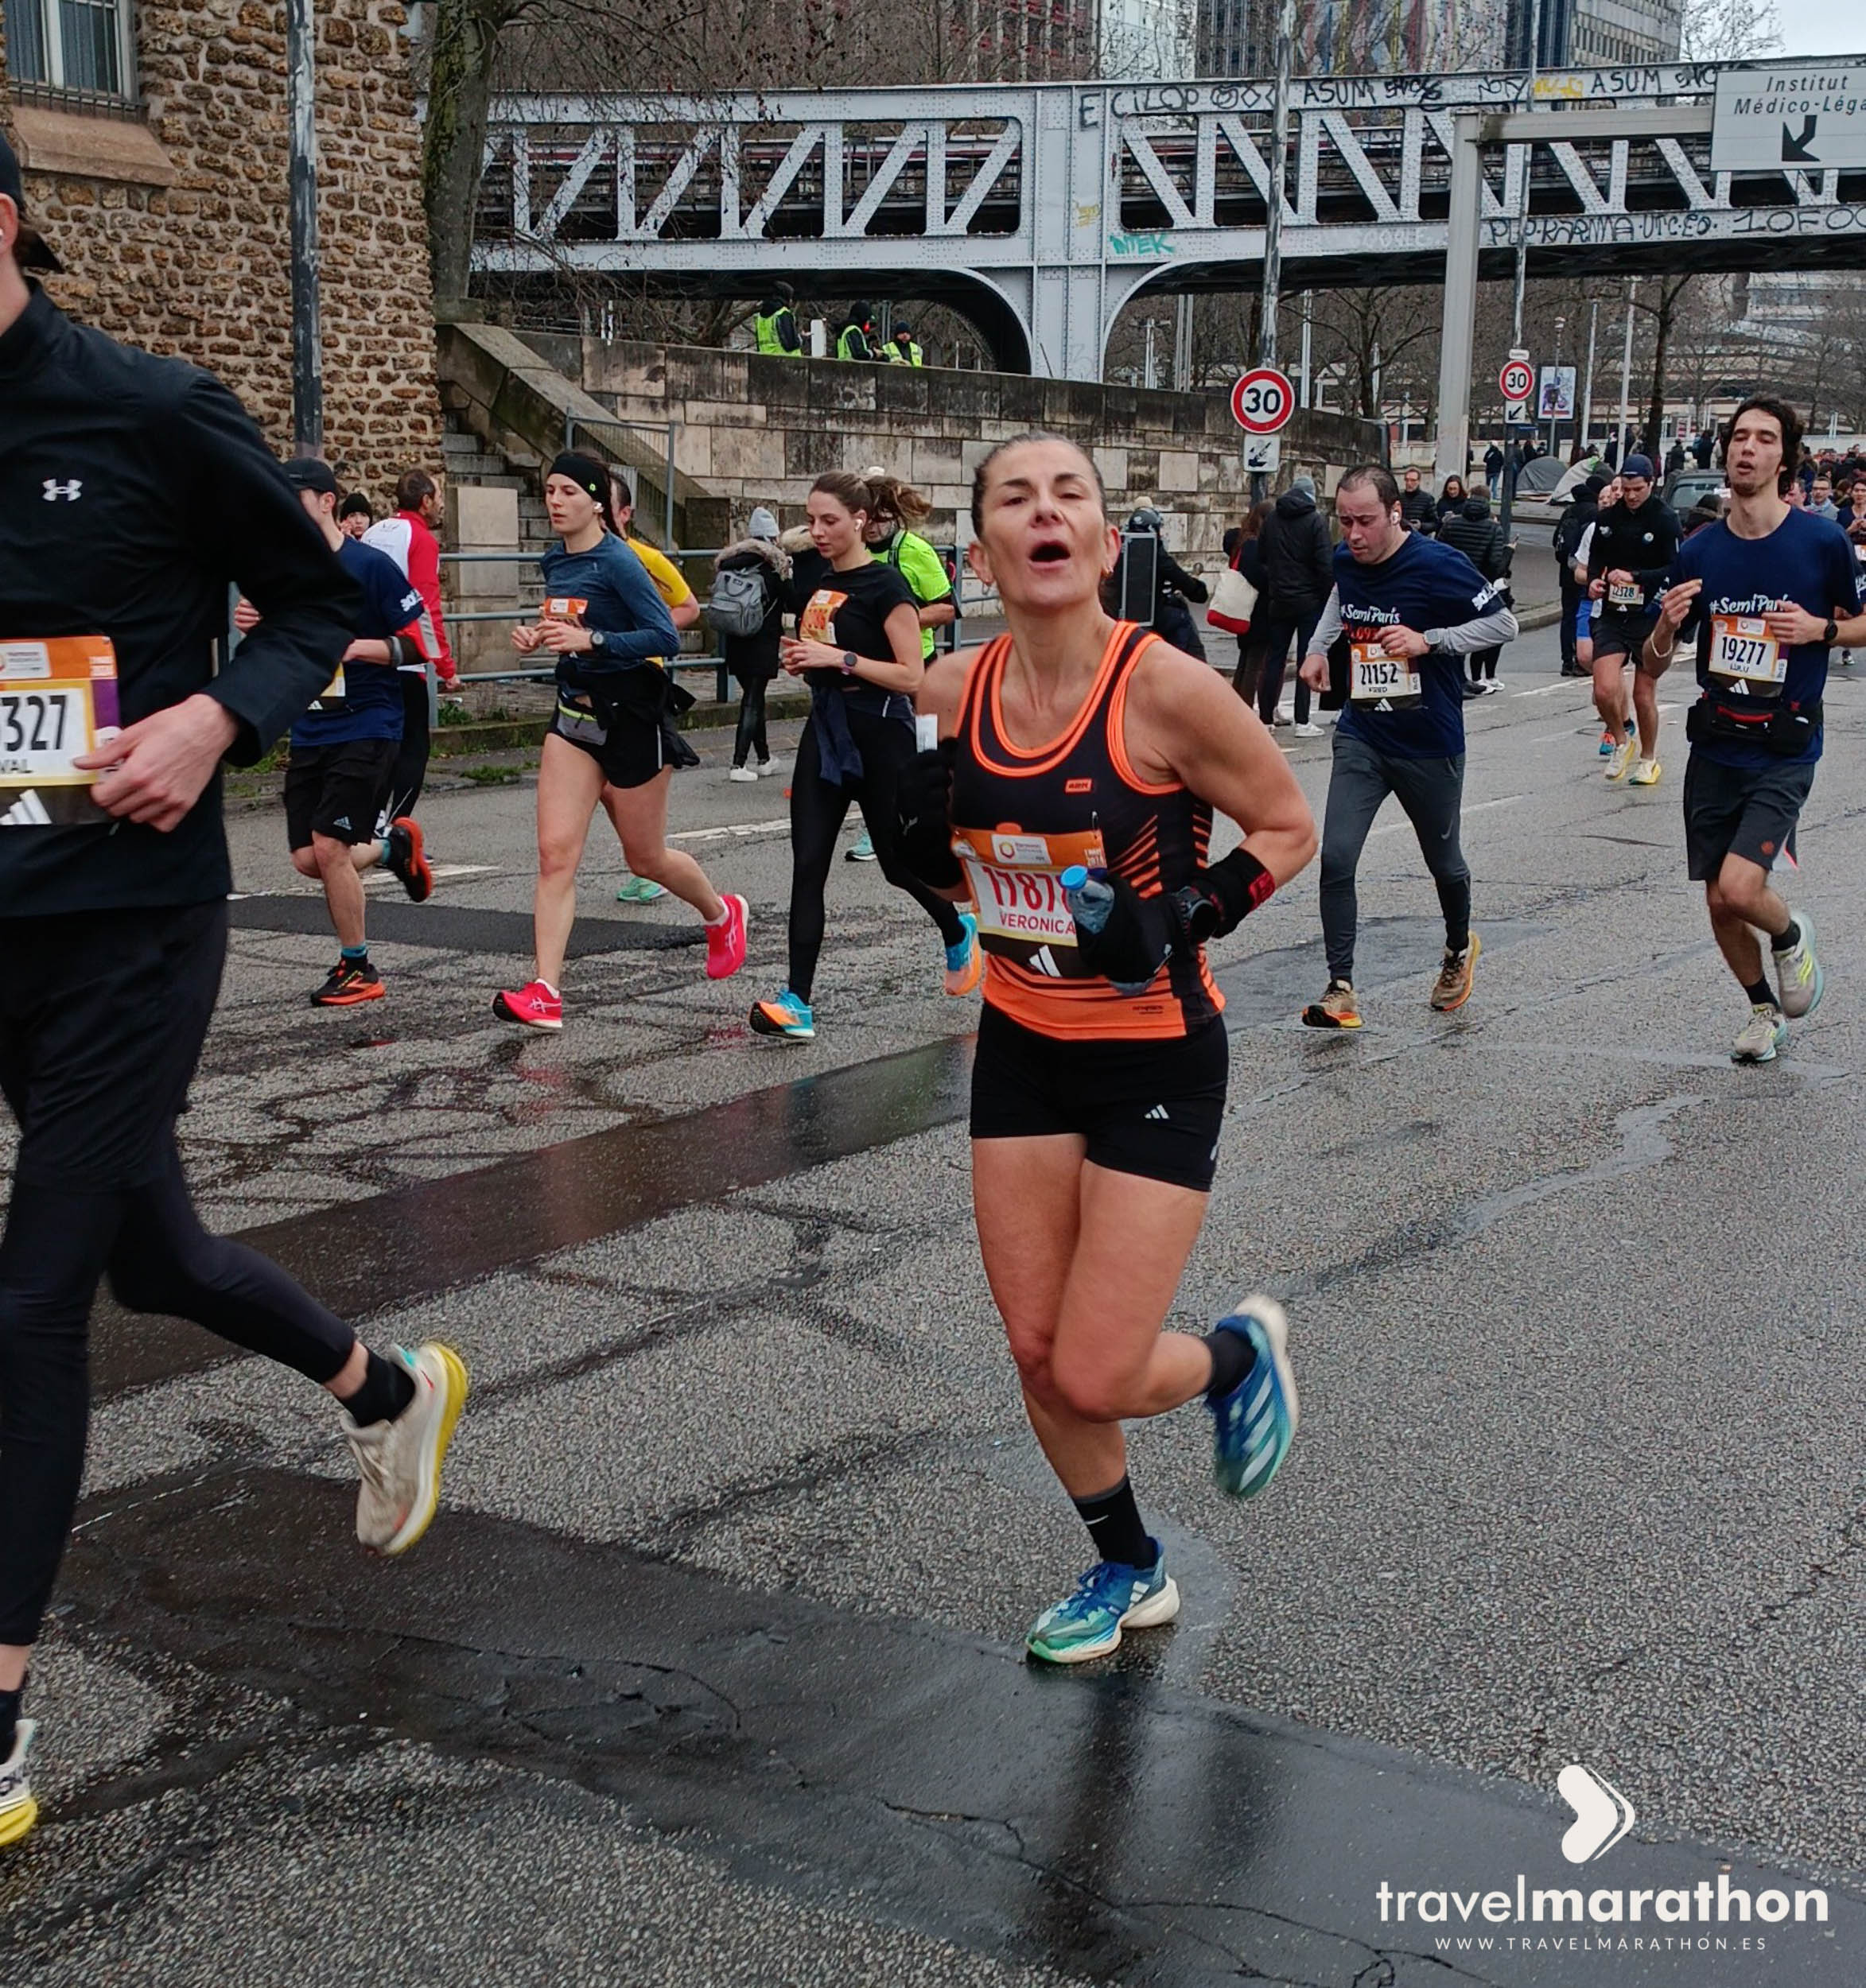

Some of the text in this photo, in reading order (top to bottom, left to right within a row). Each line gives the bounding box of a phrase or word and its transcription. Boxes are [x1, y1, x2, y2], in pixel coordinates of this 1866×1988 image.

[1592, 68, 1662, 93] ASUM
[1767, 75, 1849, 92] Institut
[1507, 372, 1526, 388] 30
[1245, 387, 1281, 414] 30
[1709, 593, 1793, 614] #SemiPari
[1722, 635, 1767, 666] 19277
[1359, 662, 1398, 685] 21152
[0, 694, 67, 752] 327
[1000, 913, 1076, 935] VERONICA
